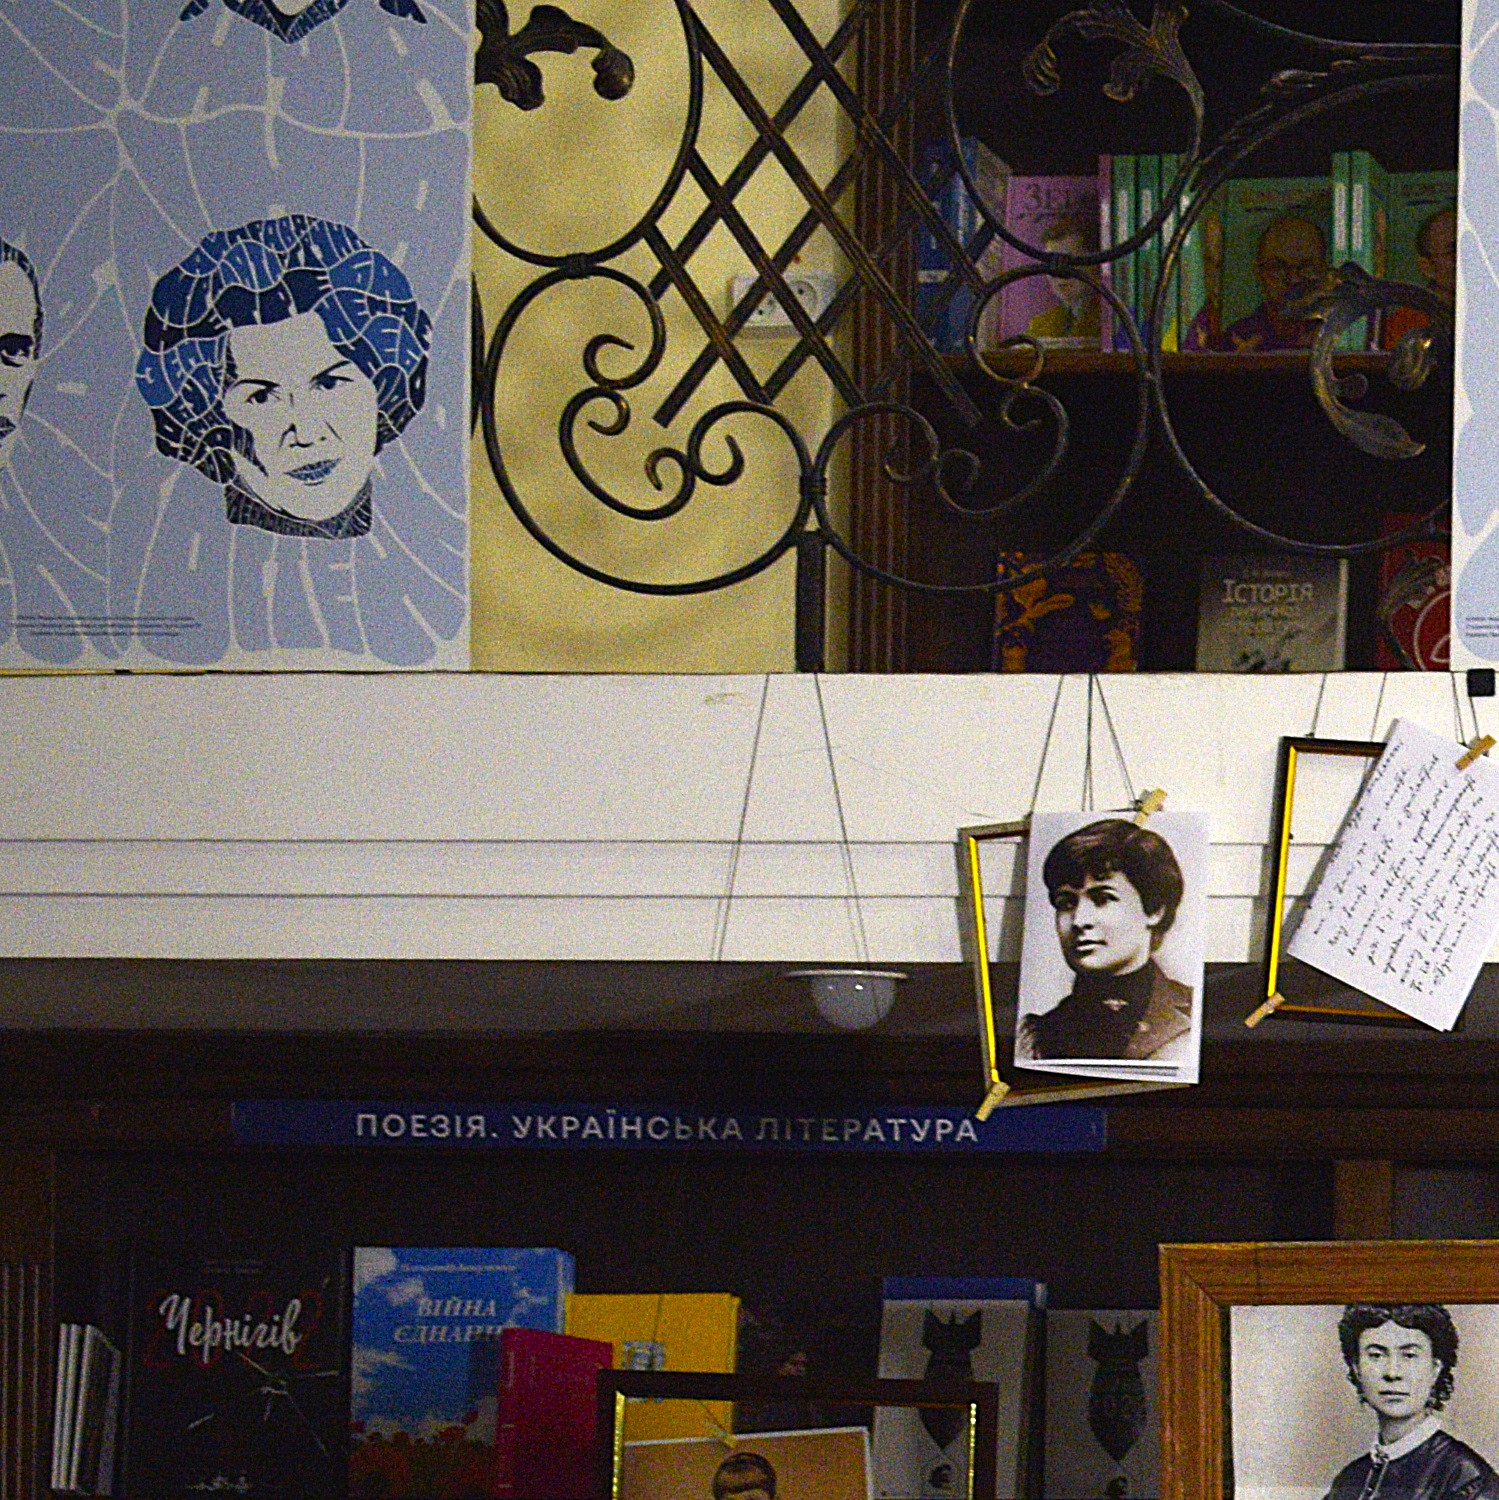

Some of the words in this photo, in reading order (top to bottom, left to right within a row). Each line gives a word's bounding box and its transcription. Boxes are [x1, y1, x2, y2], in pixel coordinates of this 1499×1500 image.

[355, 1112, 498, 1140] ПОЕЗІЯ.
[511, 1109, 743, 1143] УКРАЇНСЬКА
[754, 1115, 979, 1144] ЛІТЕРАТУРА
[416, 1295, 498, 1319] ВІЙНА
[158, 1292, 304, 1365] Чернігів
